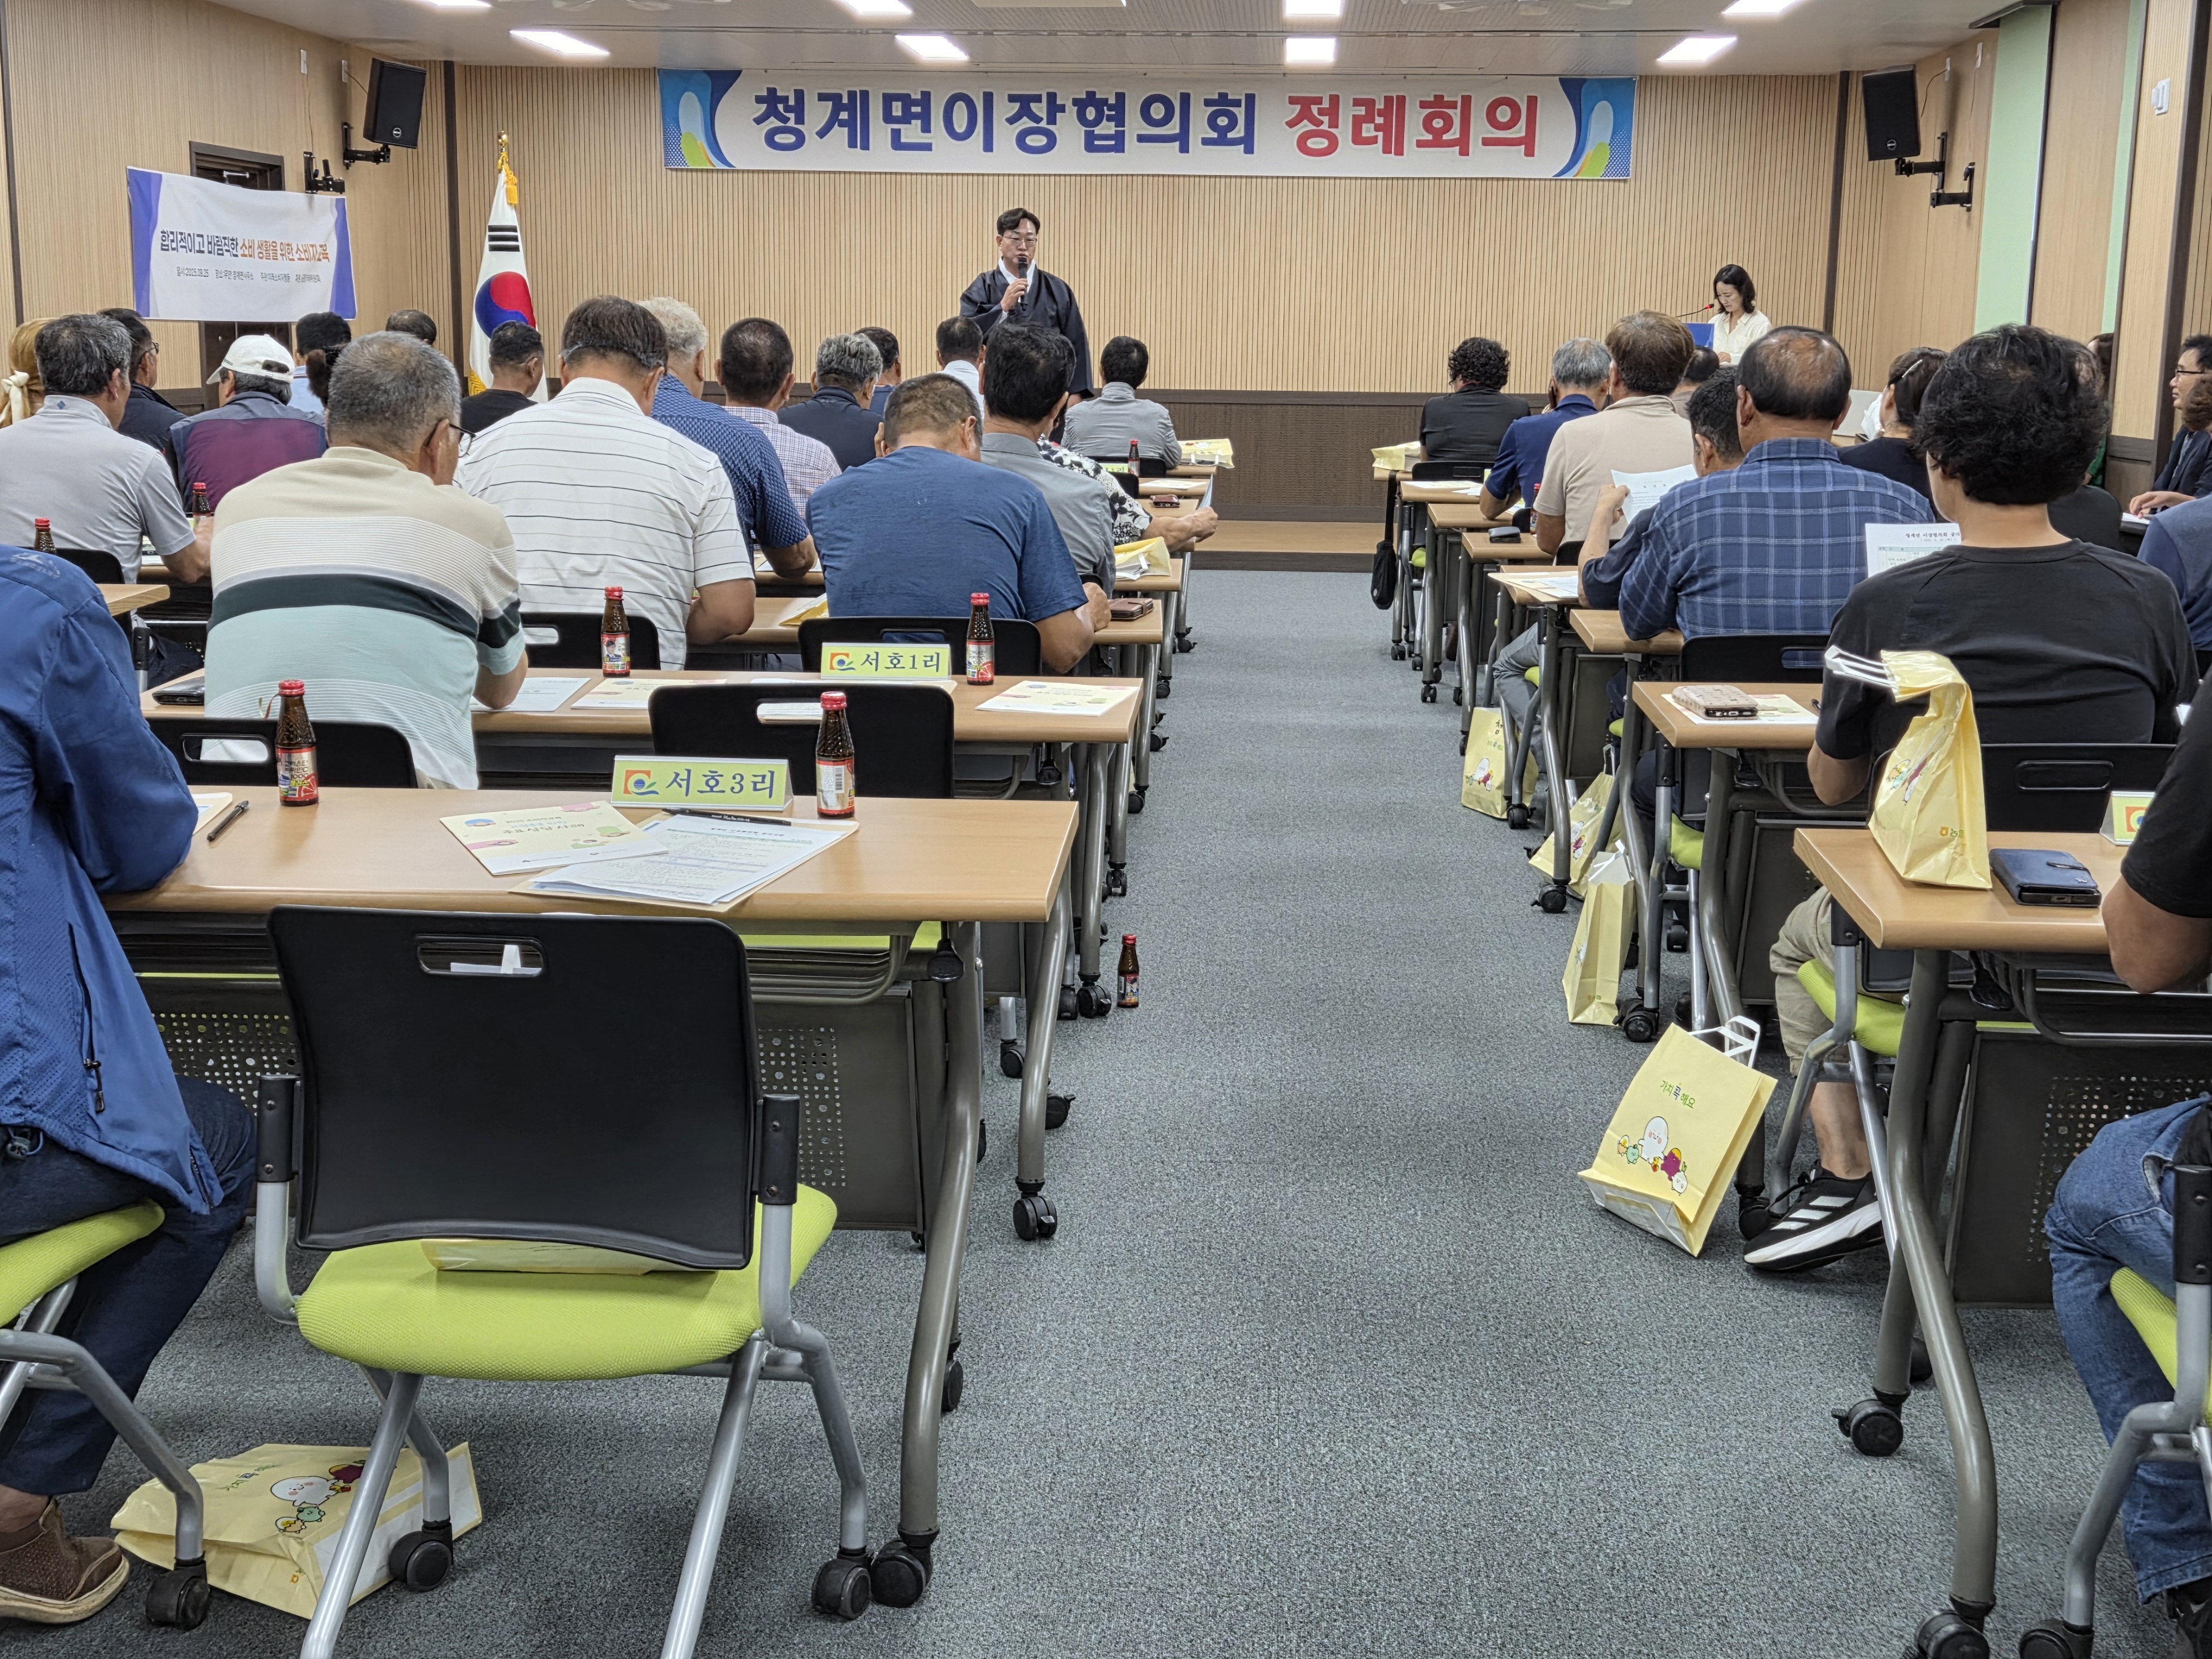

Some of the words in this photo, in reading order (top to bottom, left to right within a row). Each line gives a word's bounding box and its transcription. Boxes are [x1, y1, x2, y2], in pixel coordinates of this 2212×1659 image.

[752, 87, 1256, 154] 청계면이장협의회
[1284, 93, 1538, 157] 정례회의
[160, 229, 205, 254] 합리적이고
[207, 234, 238, 258] 바람직한
[240, 238, 255, 259] 소비
[257, 239, 279, 260] 생활을
[280, 242, 295, 262] 위한
[295, 243, 330, 263] 소비자교육
[860, 651, 941, 673] 서호1리
[666, 768, 775, 799] 서호3리
